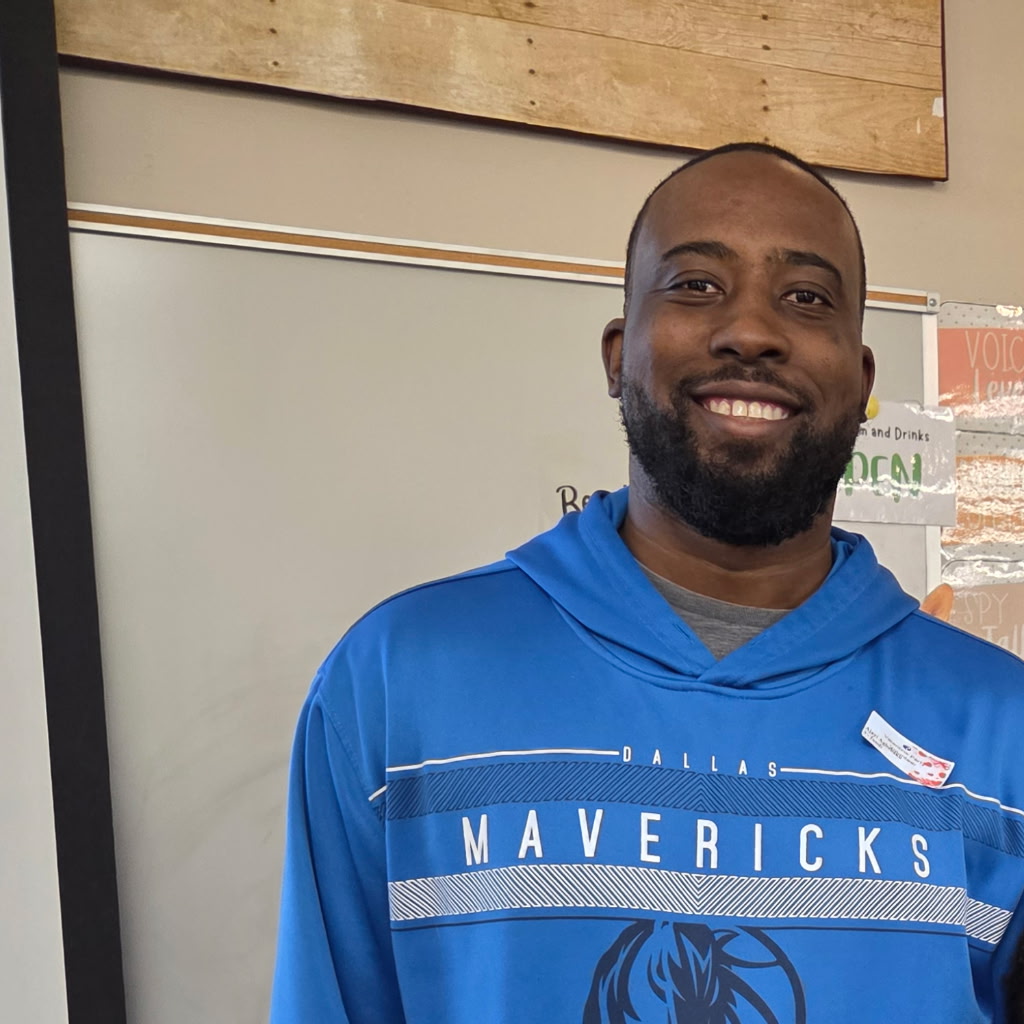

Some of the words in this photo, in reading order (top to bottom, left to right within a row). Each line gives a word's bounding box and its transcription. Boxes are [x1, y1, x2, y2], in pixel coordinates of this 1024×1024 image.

[871, 427, 890, 438] and
[895, 427, 930, 441] Drinks
[844, 451, 922, 503] PEN
[623, 746, 777, 777] DALLAS
[462, 808, 931, 877] MAVERICKS
